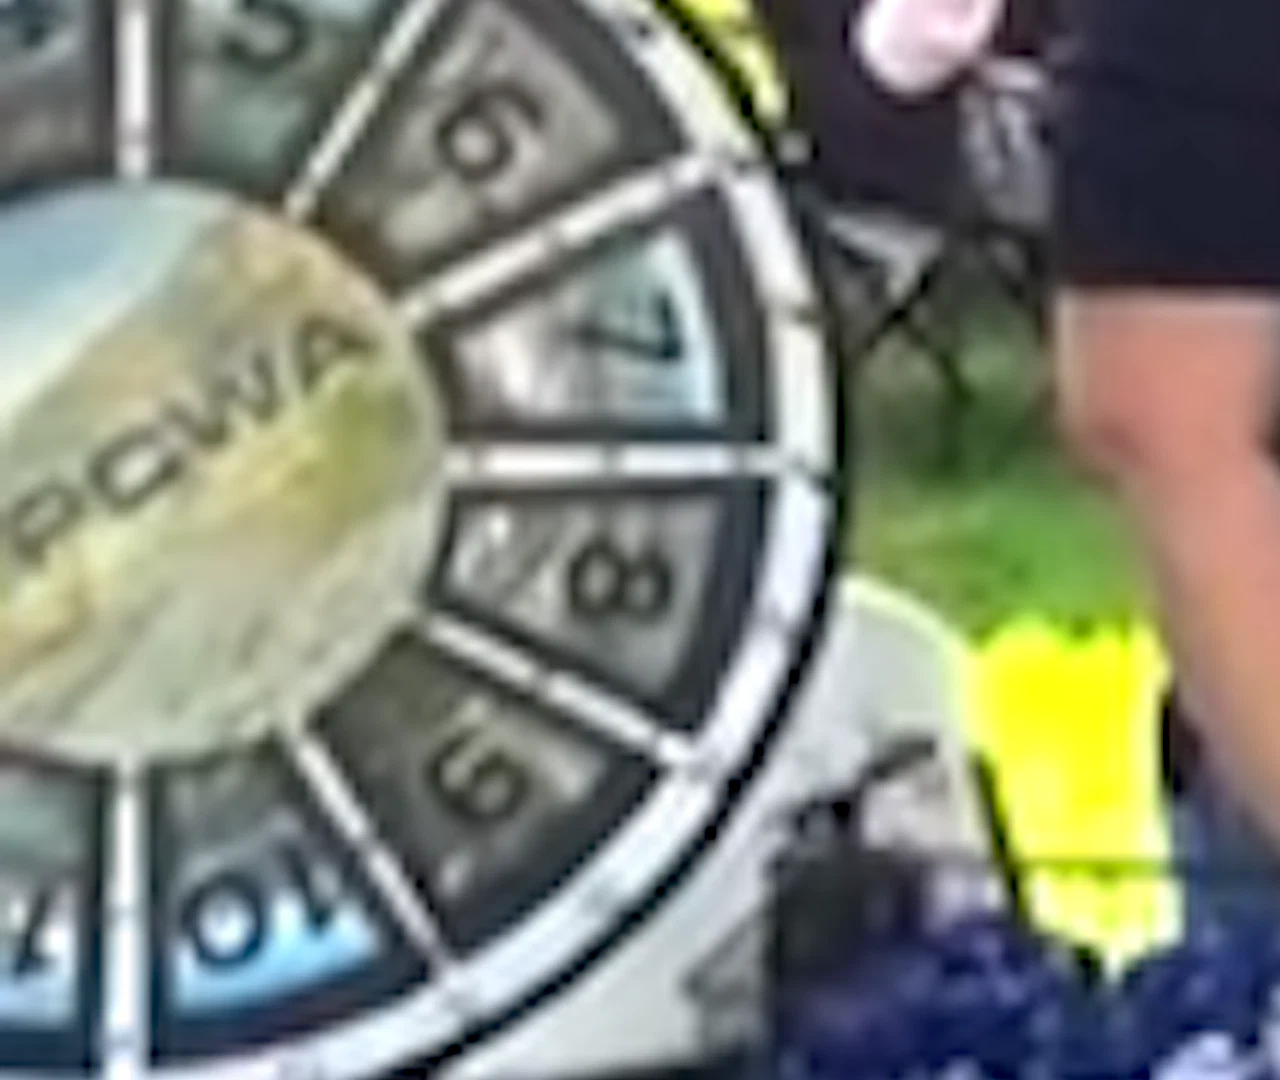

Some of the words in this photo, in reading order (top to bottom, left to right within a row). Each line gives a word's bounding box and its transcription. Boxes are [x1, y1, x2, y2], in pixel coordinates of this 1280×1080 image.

[437, 83, 545, 182] 6
[574, 290, 688, 363] 7
[7, 313, 378, 570] PCWA
[566, 535, 674, 620] 8
